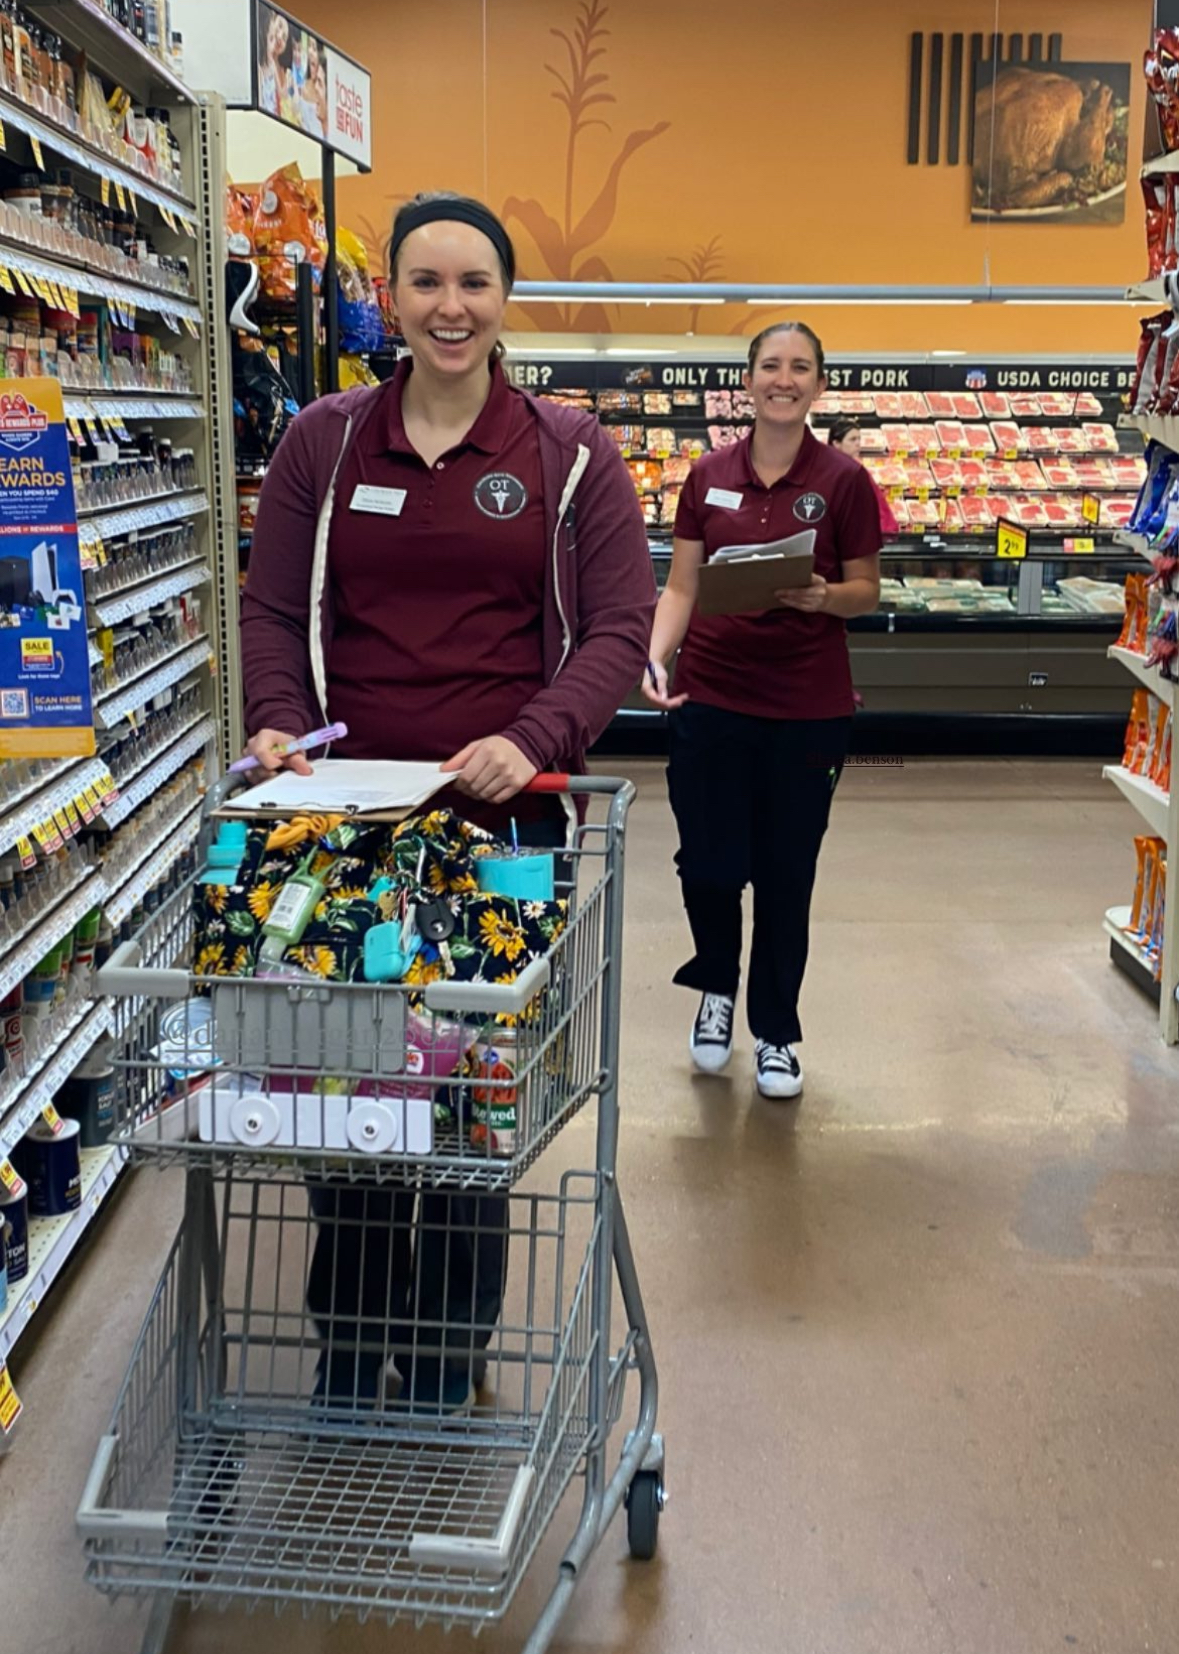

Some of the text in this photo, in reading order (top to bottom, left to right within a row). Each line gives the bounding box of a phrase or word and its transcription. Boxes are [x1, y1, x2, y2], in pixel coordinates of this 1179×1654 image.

[335, 74, 363, 118] taste
[344, 114, 364, 144] FUN
[662, 367, 709, 386] ONLY
[860, 369, 910, 387] PORK
[997, 371, 1041, 388] USDA
[1048, 371, 1109, 388] CHOICE
[0, 457, 44, 471] EARN
[0, 472, 66, 488] WARDS
[489, 479, 510, 491] OT
[24, 489, 45, 497] SPEND
[29, 525, 64, 533] REWARDS
[26, 641, 49, 650] SALE
[34, 696, 81, 705] SCAN HERE
[66, 704, 83, 712] MORE
